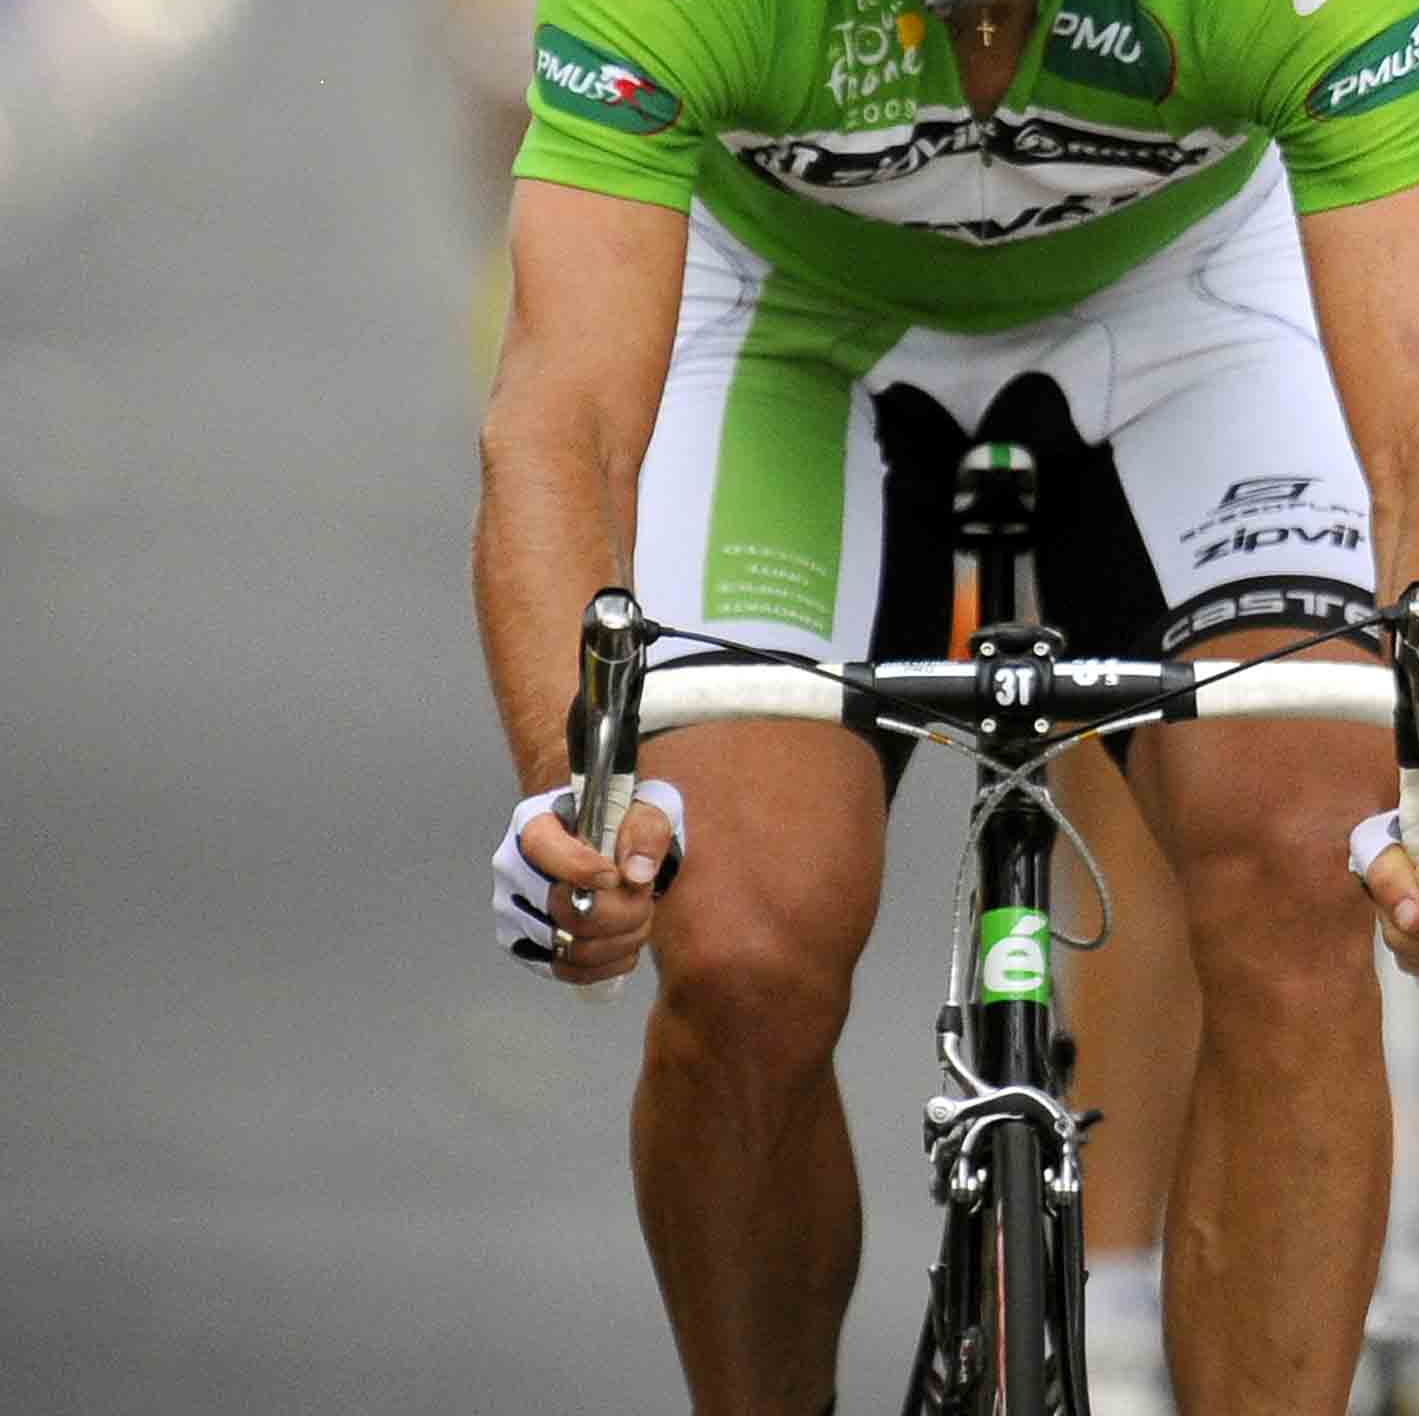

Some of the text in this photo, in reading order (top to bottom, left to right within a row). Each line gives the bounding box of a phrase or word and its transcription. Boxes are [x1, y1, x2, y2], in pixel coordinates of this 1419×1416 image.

[1053, 11, 1142, 64] PMU
[535, 48, 598, 94] PMU
[1328, 45, 1412, 105] PMU
[993, 667, 1035, 707] 3T
